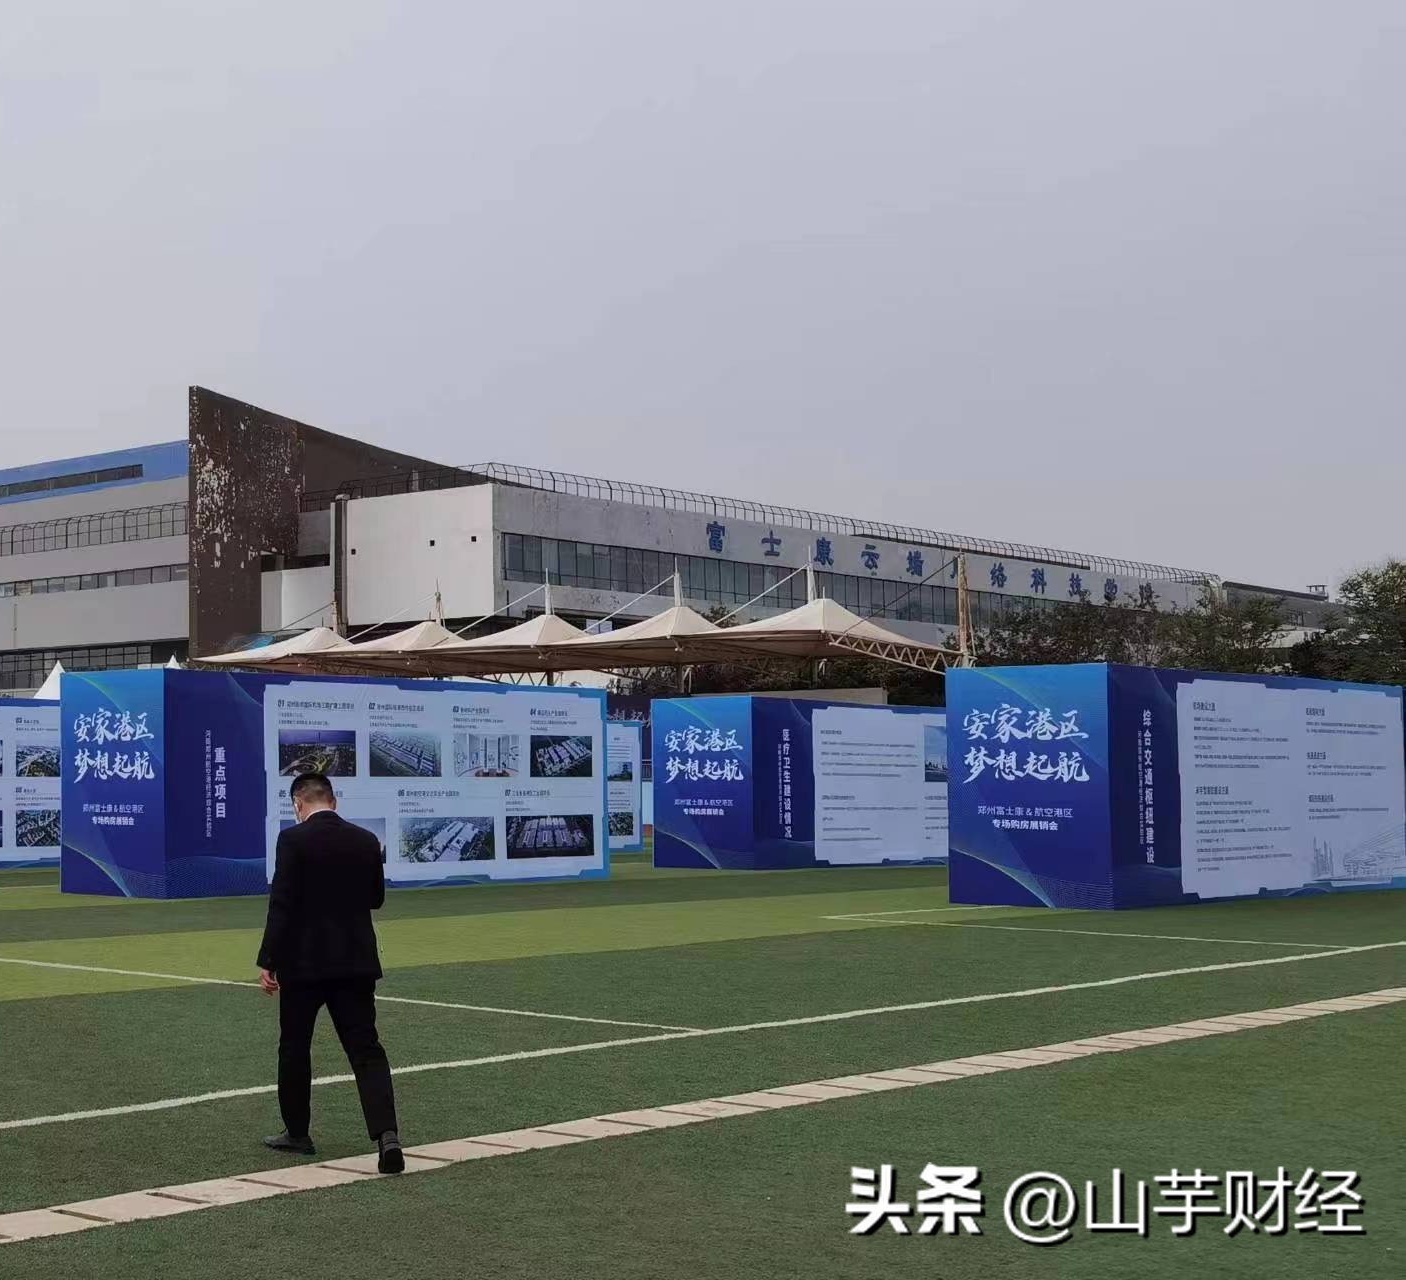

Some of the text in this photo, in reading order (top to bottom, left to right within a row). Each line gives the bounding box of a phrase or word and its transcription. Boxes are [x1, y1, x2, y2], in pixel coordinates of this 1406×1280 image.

[73, 708, 154, 745] 安家港区
[664, 725, 743, 754] 安家港区
[962, 703, 1089, 743] 安家港区
[73, 748, 155, 784] 梦想起航
[214, 746, 226, 818] 重点项目
[665, 756, 744, 784] 梦想起航
[963, 746, 1090, 784] 梦想起航
[992, 819, 1058, 830] 专场购房展销会
